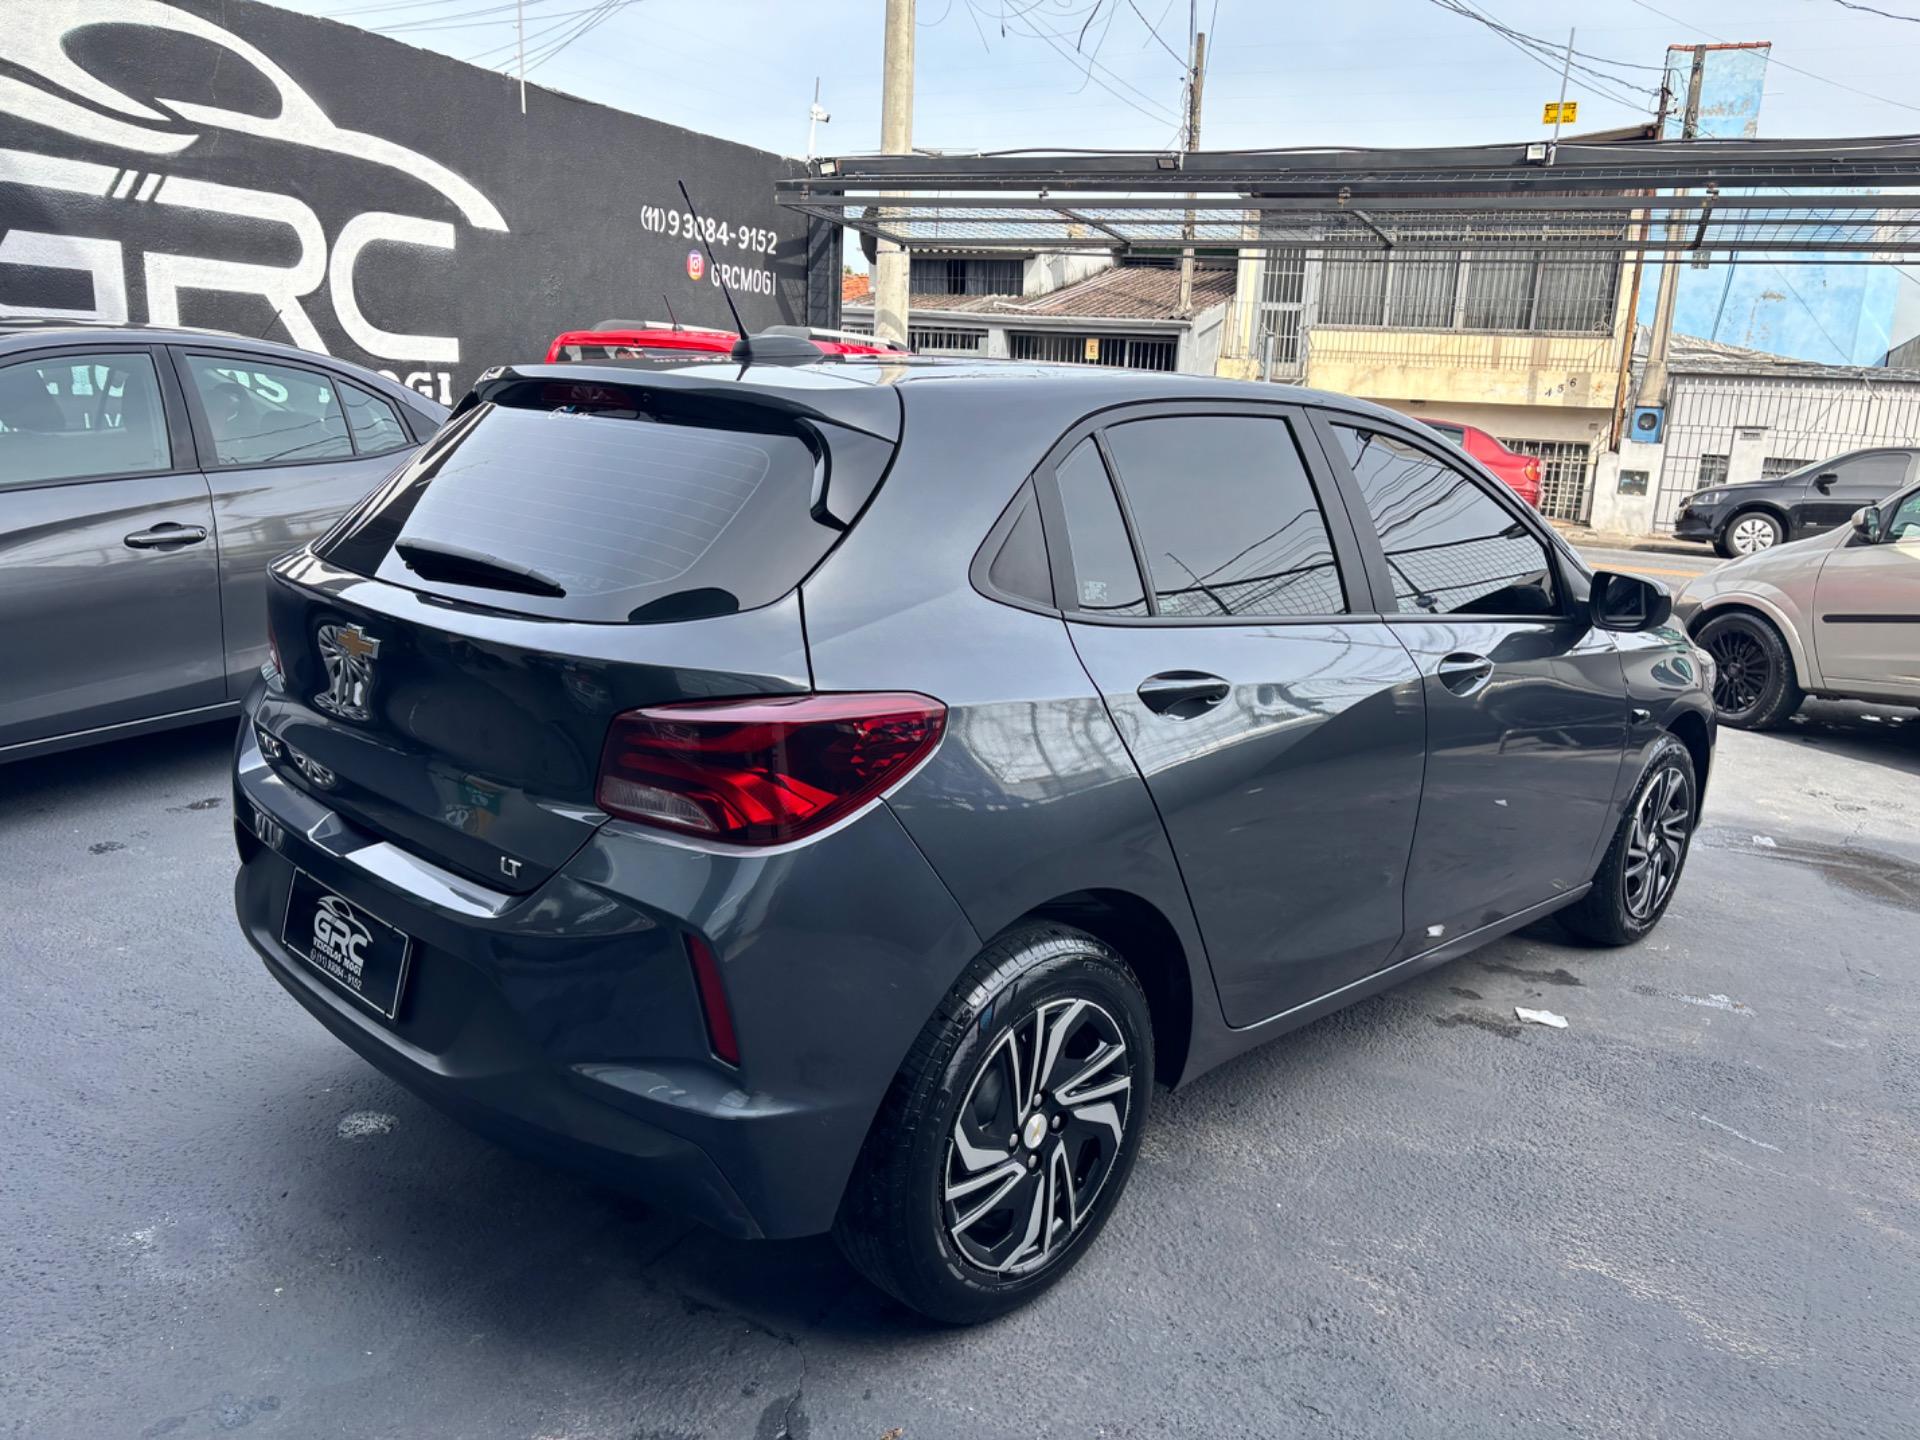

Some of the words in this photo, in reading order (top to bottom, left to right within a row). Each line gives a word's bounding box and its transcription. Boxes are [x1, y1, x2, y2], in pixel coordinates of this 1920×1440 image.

[710, 263, 777, 295] GRCMOGI
[501, 856, 522, 878] LT
[314, 909, 368, 967] GRC
